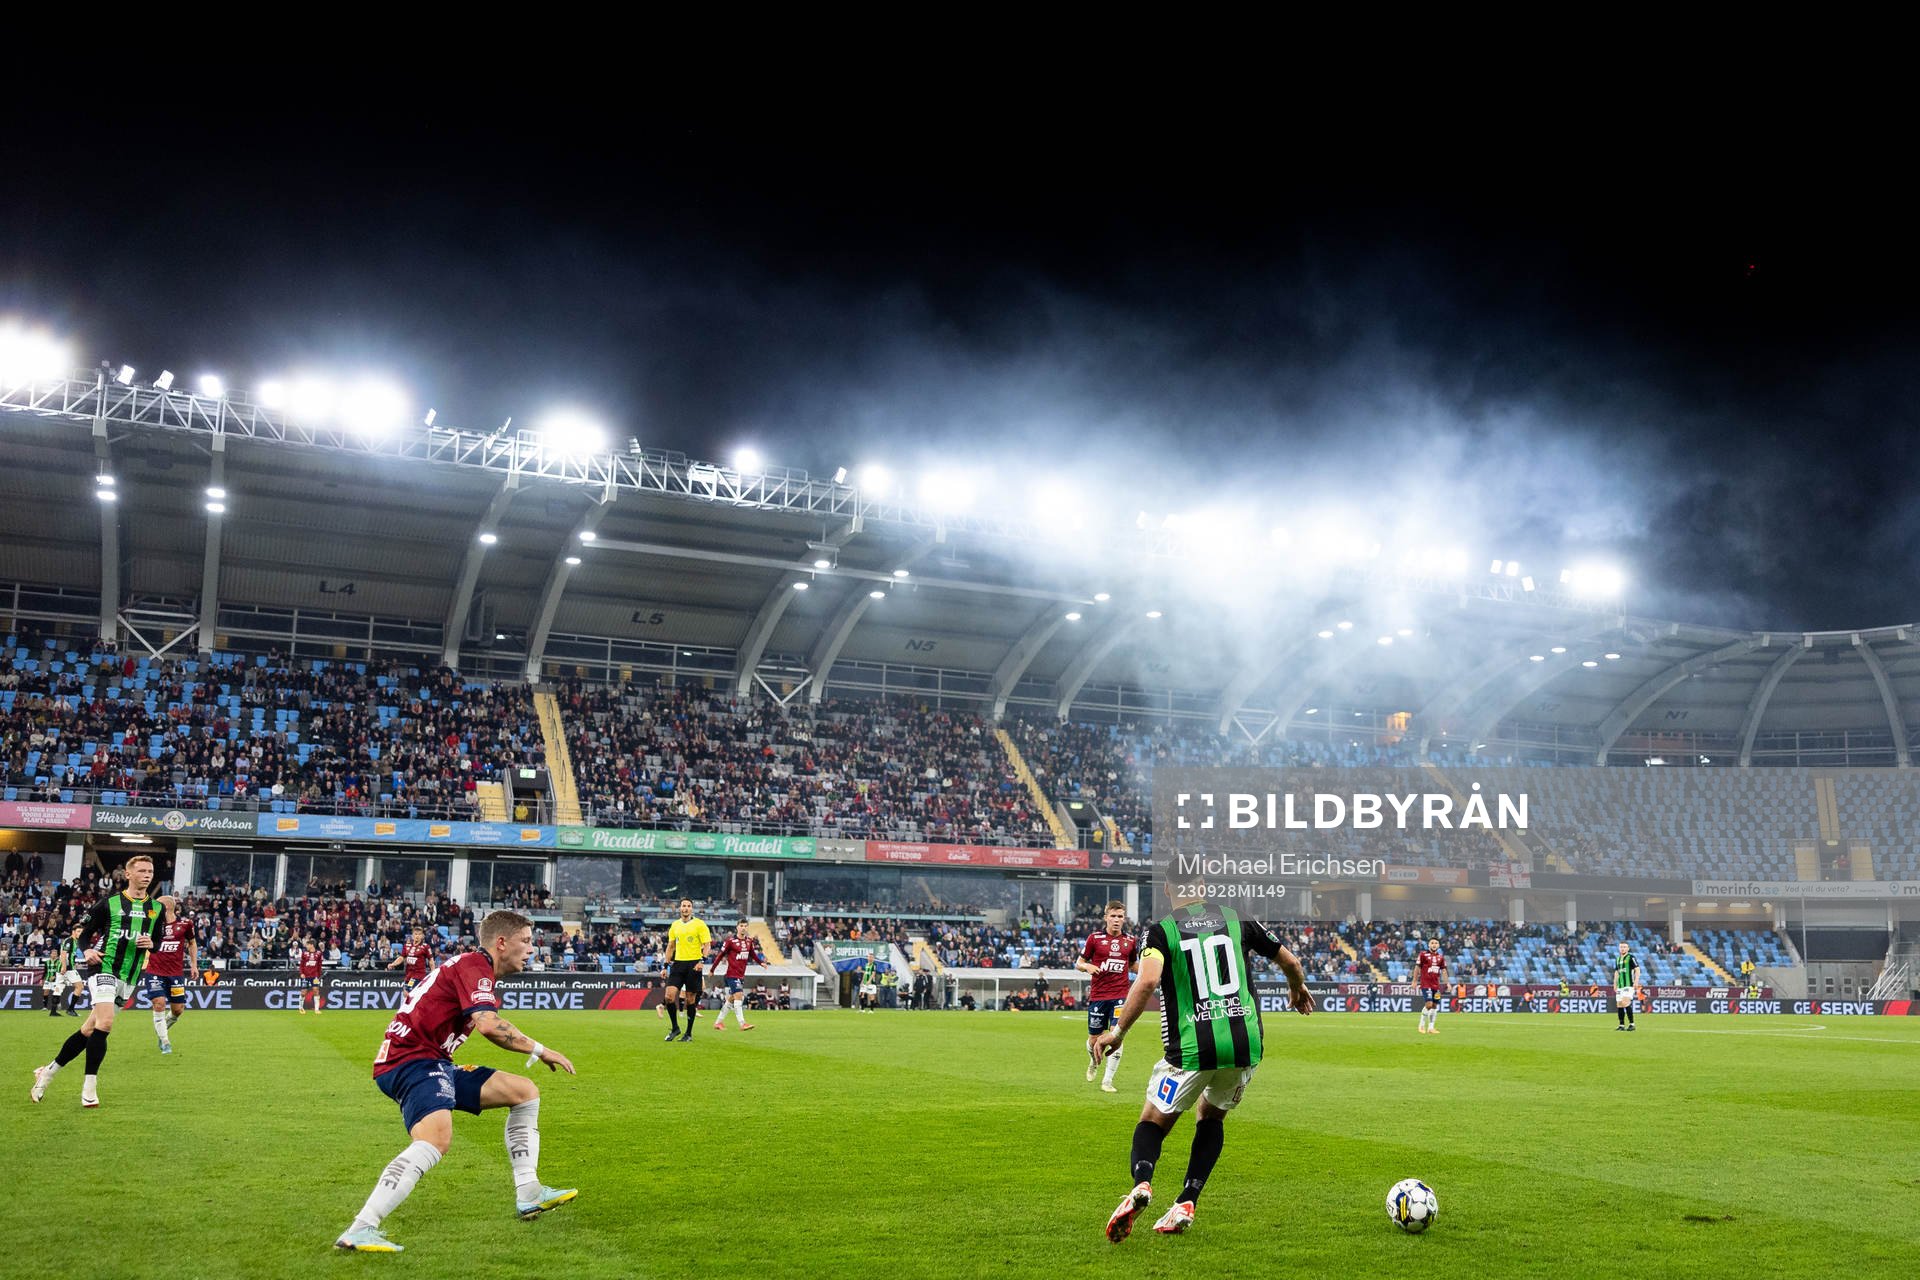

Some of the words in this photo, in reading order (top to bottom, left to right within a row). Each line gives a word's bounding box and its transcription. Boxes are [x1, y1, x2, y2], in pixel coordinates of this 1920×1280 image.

[319, 580, 357, 595] L4
[631, 611, 664, 625] L5
[905, 639, 937, 652] N5
[1664, 709, 1689, 720] N1
[96, 811, 148, 828] Härryda
[200, 816, 253, 830] Karlsson
[592, 830, 656, 849] Picadeli
[723, 836, 782, 854] Picadeli
[1706, 882, 1779, 896] merinfo.se
[1179, 934, 1240, 999] 10
[1195, 997, 1241, 1012] NORDIC
[1186, 1006, 1252, 1022] WELLNESS
